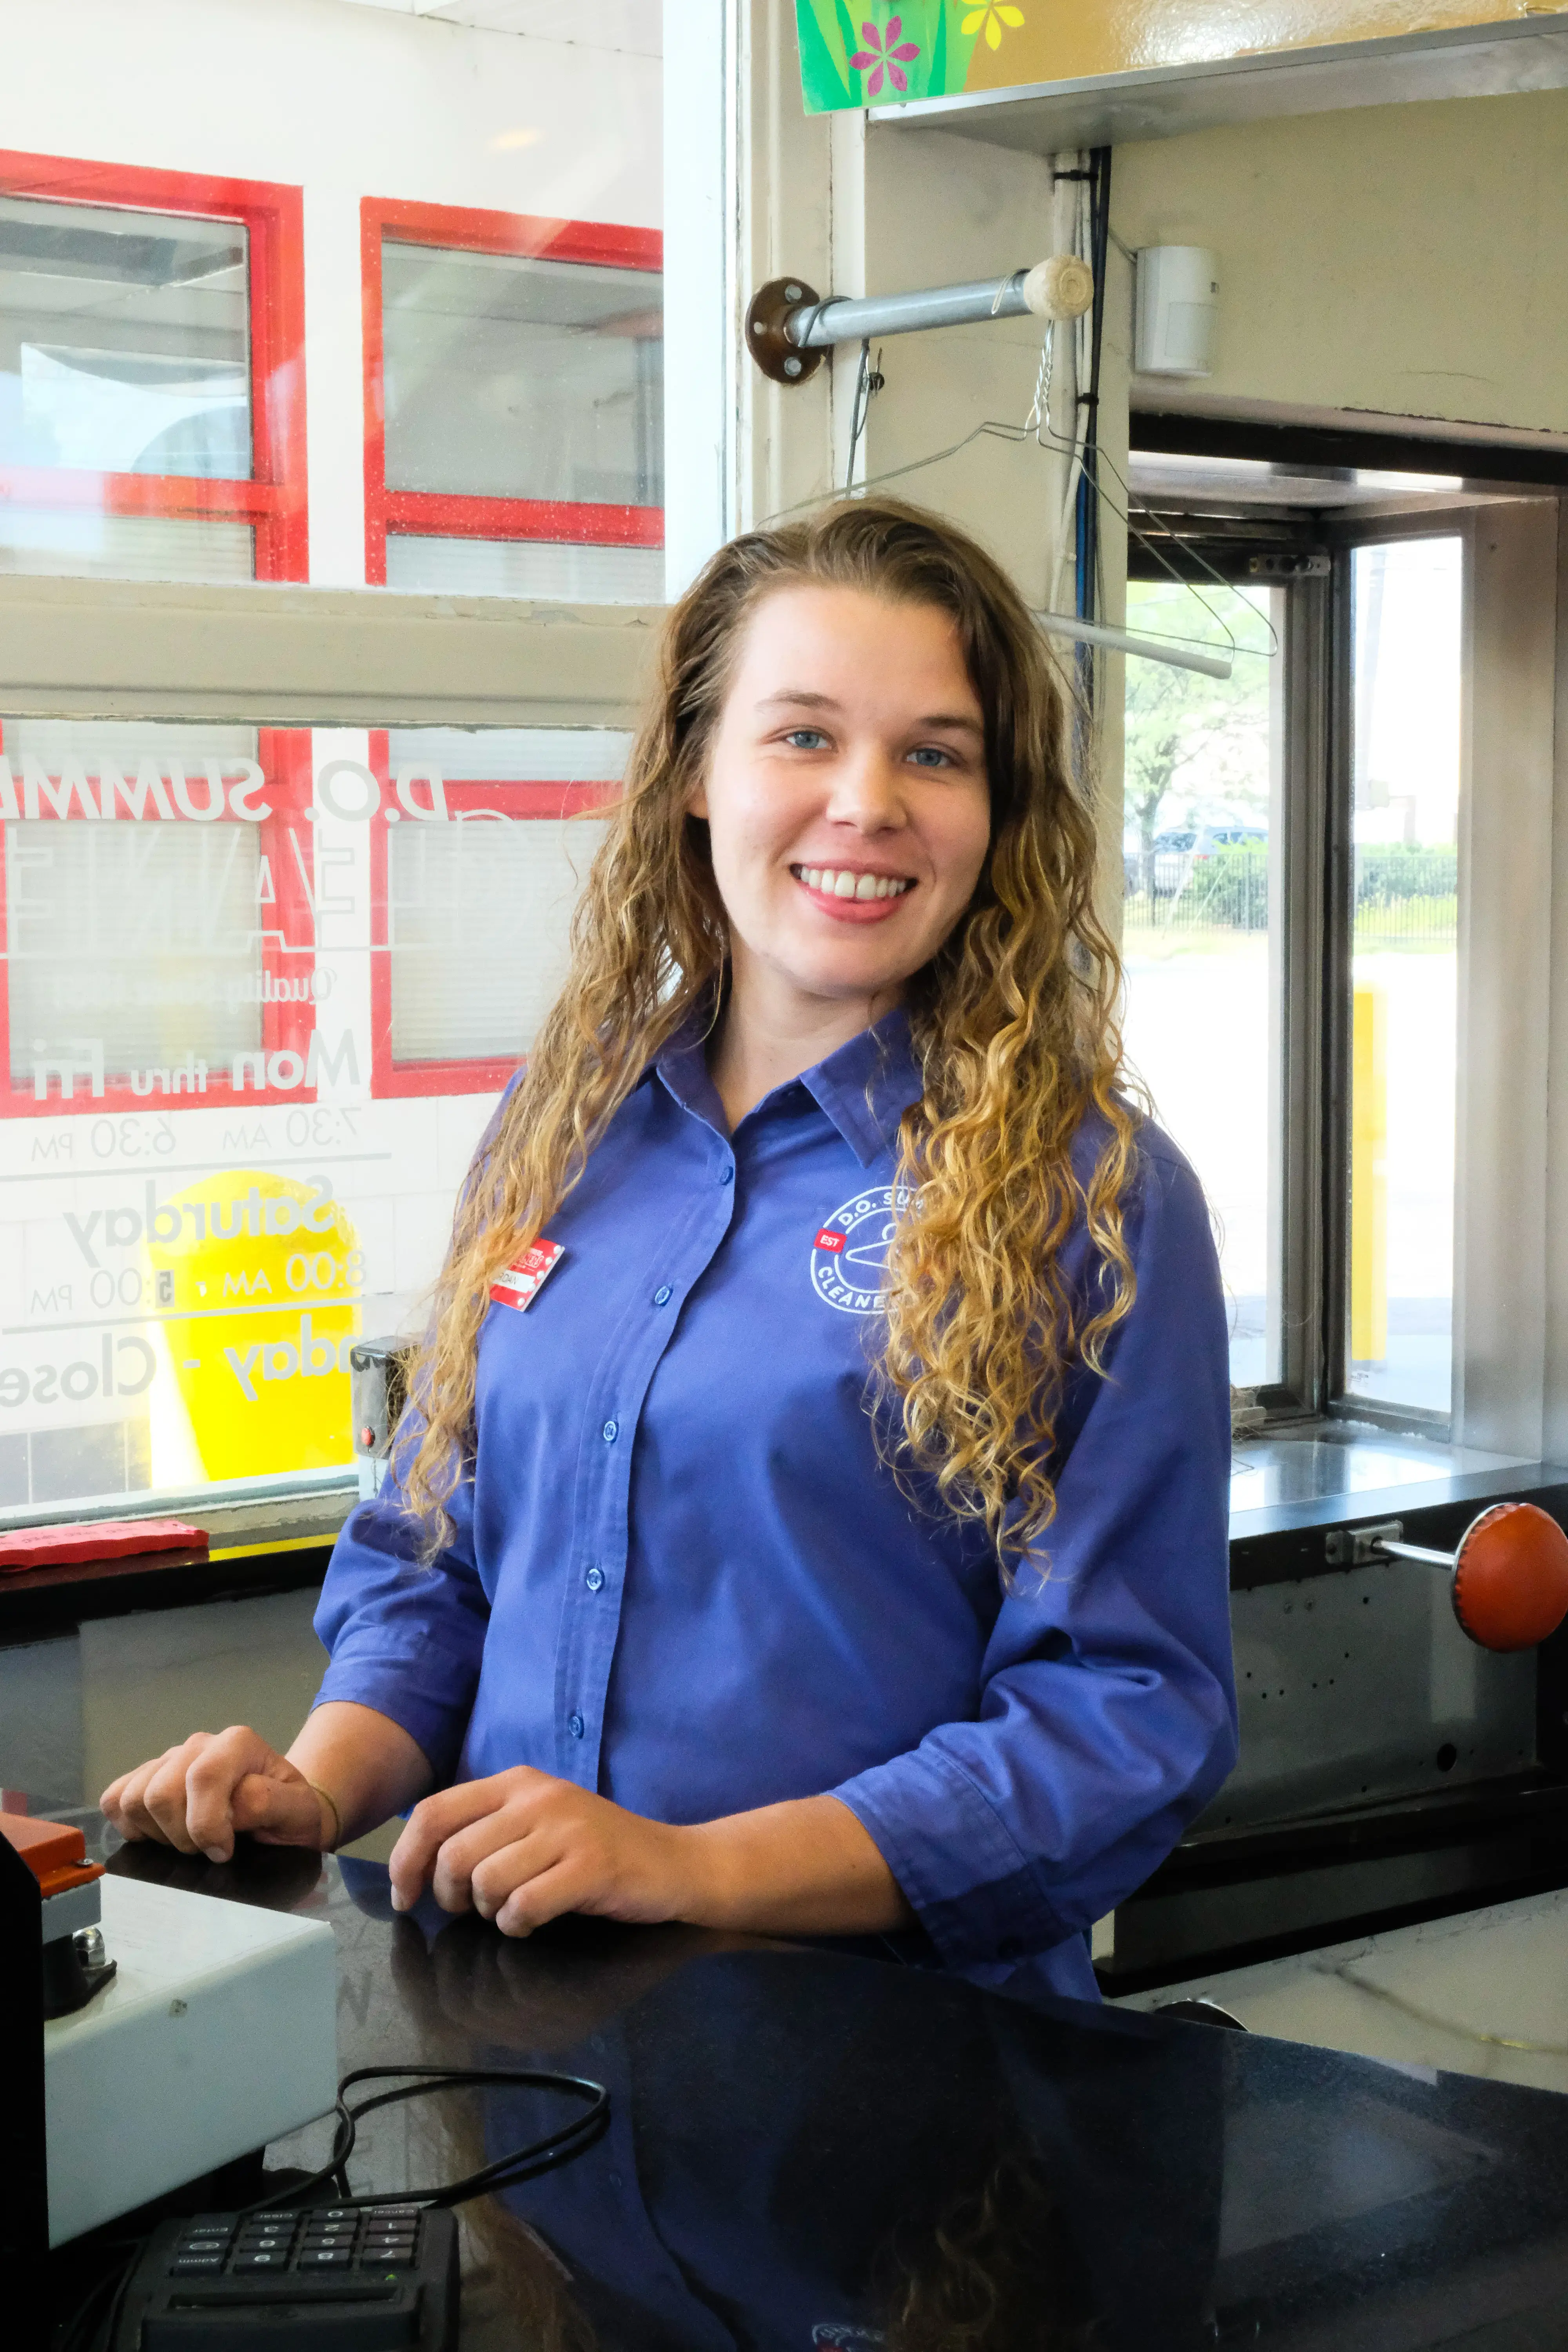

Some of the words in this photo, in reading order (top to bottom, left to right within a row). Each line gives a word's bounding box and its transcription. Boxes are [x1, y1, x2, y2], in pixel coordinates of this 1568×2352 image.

[838, 1200, 877, 1226] D.O.
[819, 1234, 840, 1247] EST
[818, 1266, 886, 1308] CLEANE
